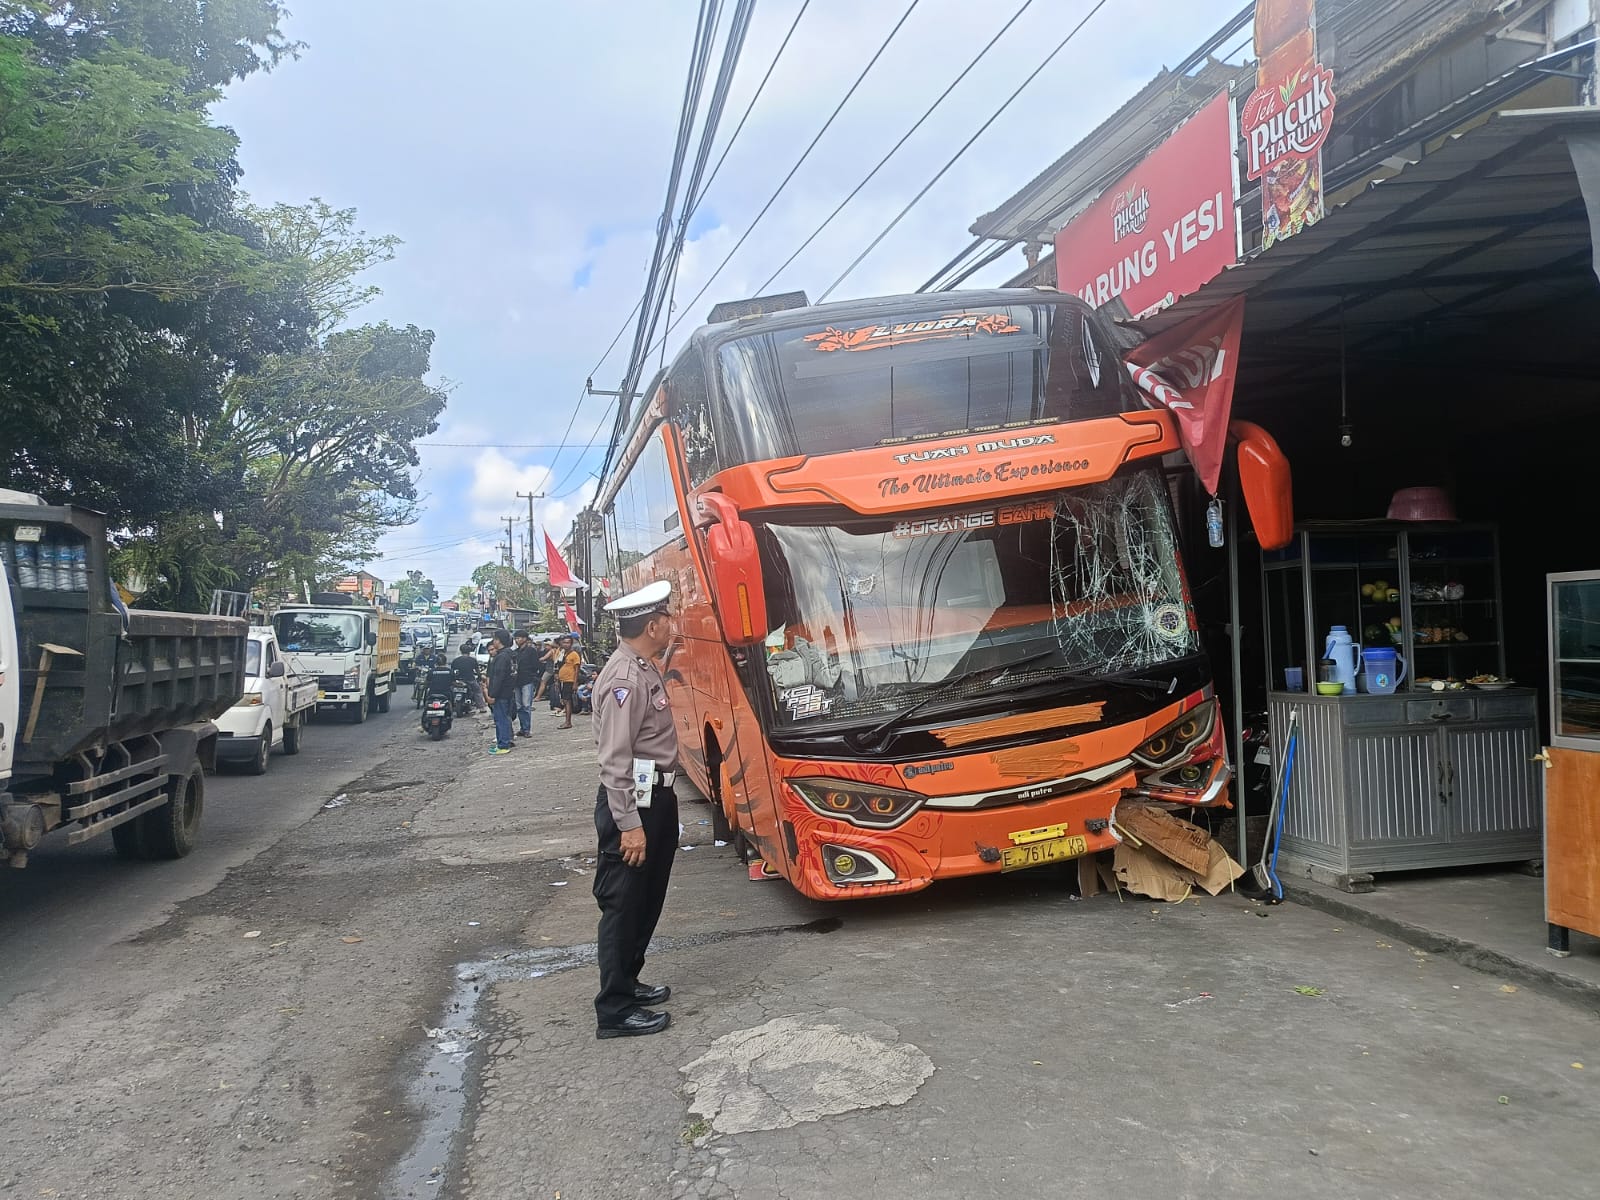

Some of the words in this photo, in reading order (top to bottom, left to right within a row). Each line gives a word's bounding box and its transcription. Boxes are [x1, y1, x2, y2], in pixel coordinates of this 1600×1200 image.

[1265, 112, 1325, 165] HARUM
[1119, 211, 1147, 238] HARUM
[1162, 191, 1224, 262] YESI
[893, 443, 969, 465] TUAN
[976, 434, 1056, 453] MUDA
[878, 476, 910, 498] The
[912, 467, 992, 494] Ultimate
[994, 459, 1090, 482] Experience
[1003, 851, 1012, 867] E
[1023, 841, 1054, 862] 7614
[1067, 837, 1085, 856] KB
